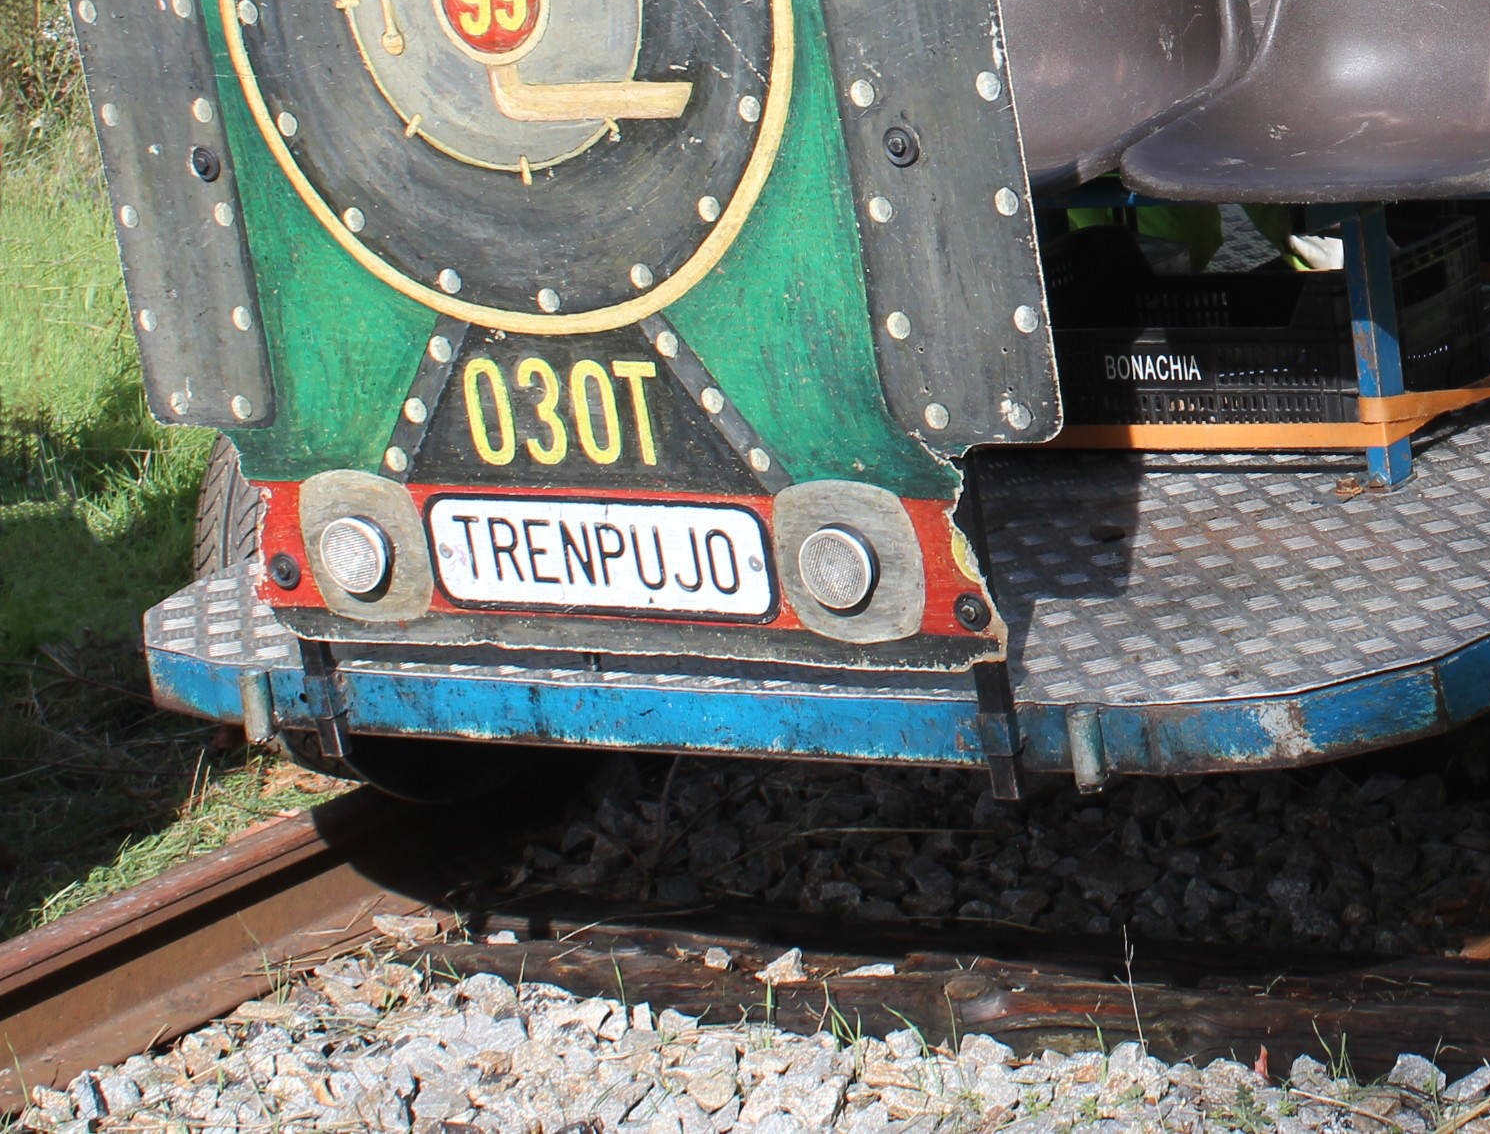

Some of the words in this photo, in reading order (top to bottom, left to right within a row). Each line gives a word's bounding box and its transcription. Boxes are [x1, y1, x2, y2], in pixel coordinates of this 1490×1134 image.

[1105, 354, 1202, 381] BONACHIA
[463, 357, 658, 466] 030T
[452, 515, 740, 595] TRENPUJO
